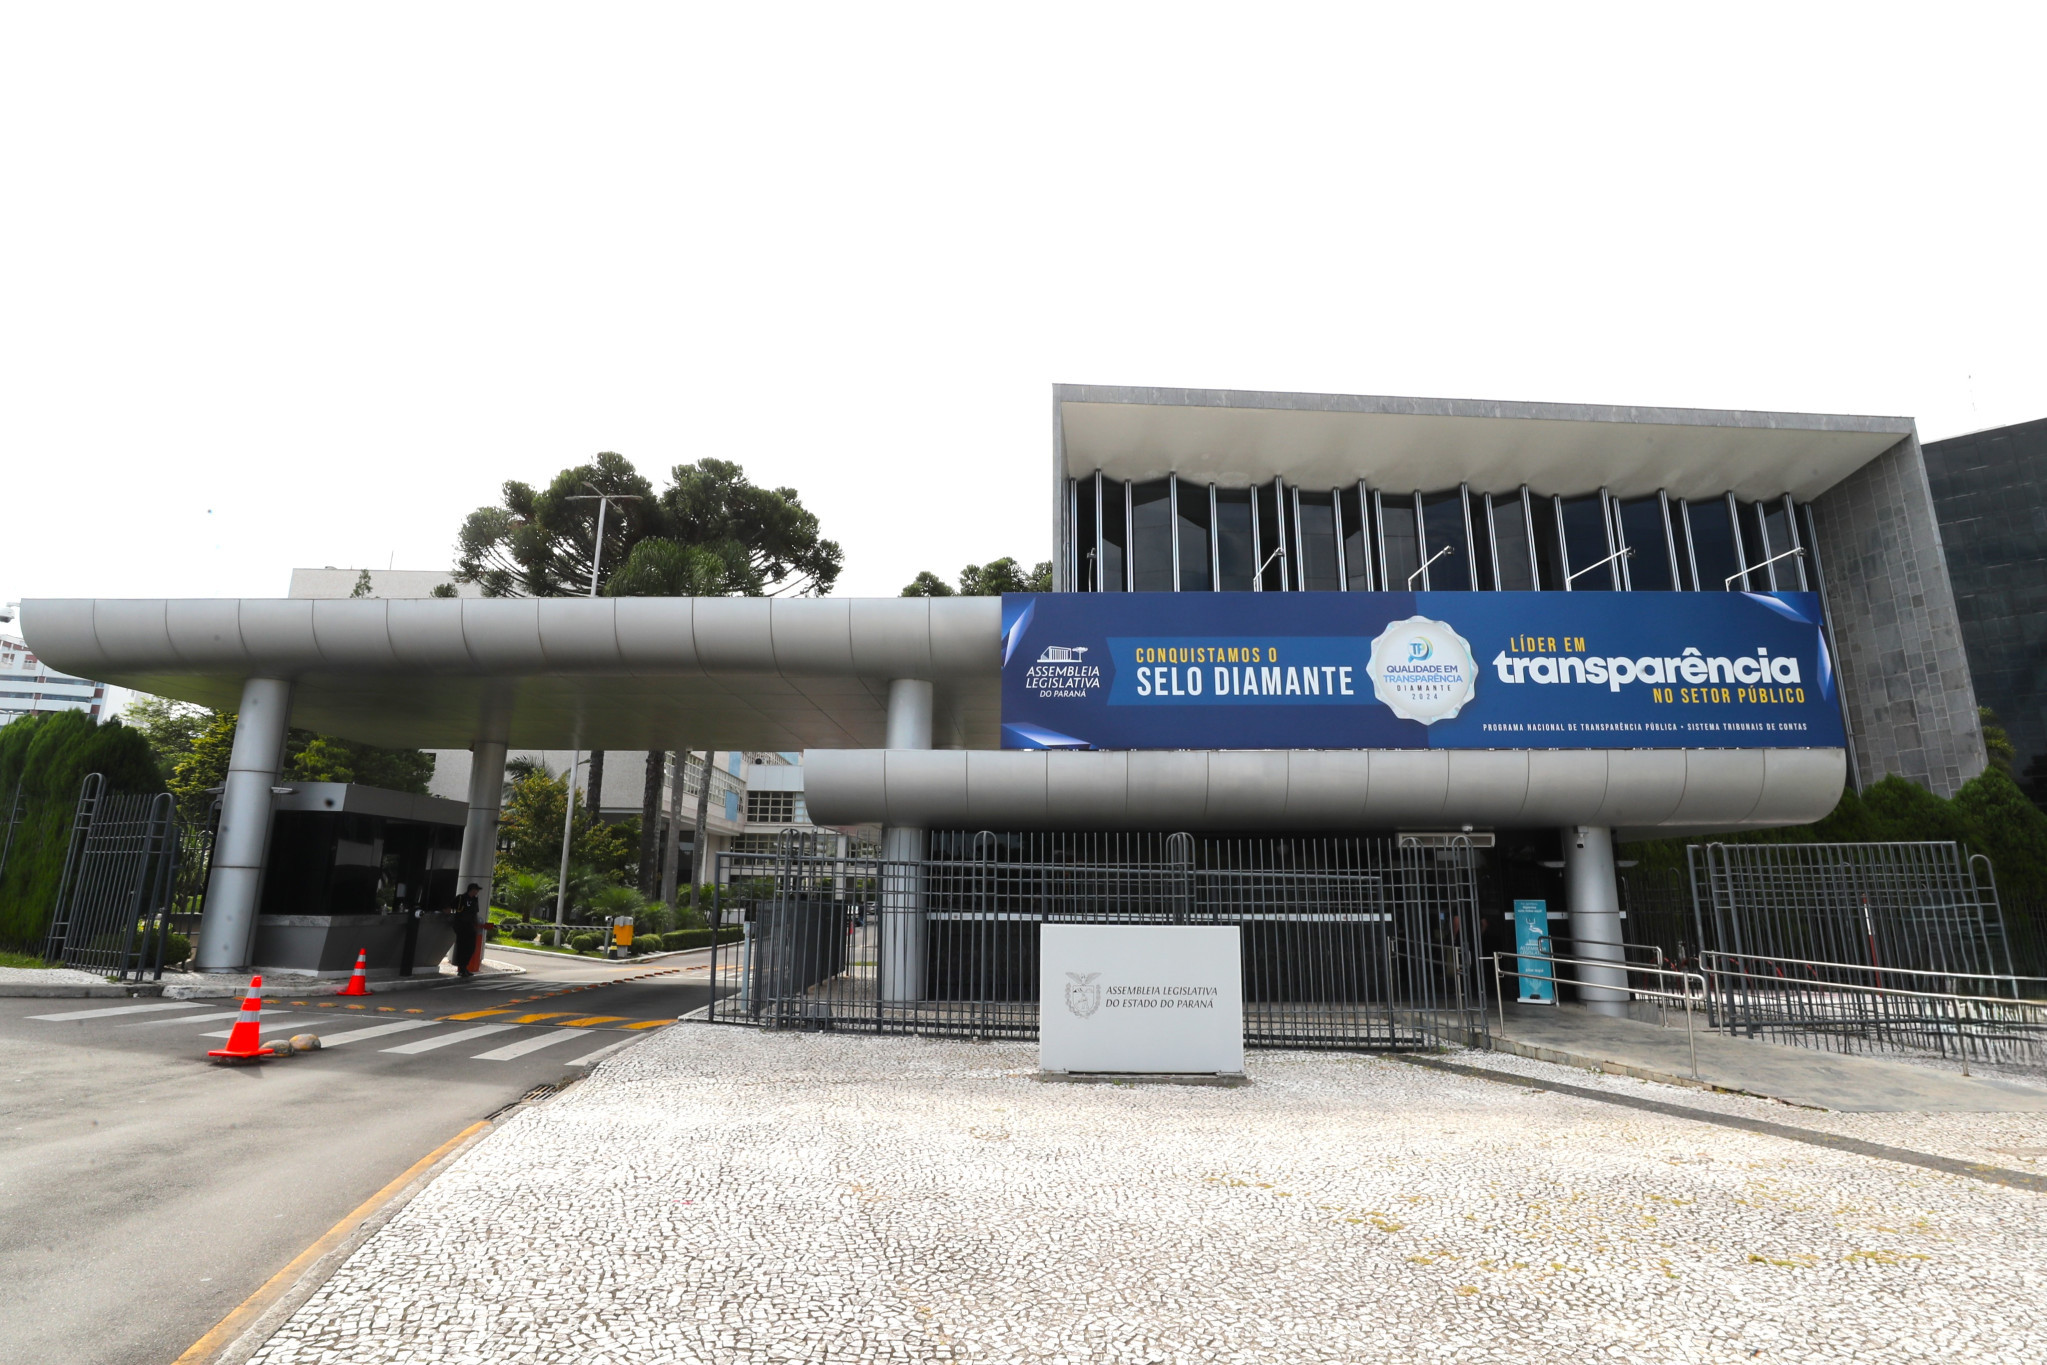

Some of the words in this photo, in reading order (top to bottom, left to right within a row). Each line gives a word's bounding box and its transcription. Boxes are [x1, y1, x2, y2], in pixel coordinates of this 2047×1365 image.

[1510, 634, 1556, 653] LÍDER
[1564, 637, 1586, 653] EM
[1136, 648, 1260, 663] CONQUISTAMOS
[1269, 648, 1278, 663] O
[1026, 666, 1100, 677] ASSEMBLEIA
[1386, 665, 1442, 673] QUALIDADE
[1444, 665, 1458, 673] EM
[1492, 647, 1800, 693] transparência
[1025, 677, 1100, 689] LEGISLATIVA
[1136, 666, 1204, 696] SELO
[1215, 666, 1355, 696] DIAMANTE
[1383, 674, 1463, 682] TRANSPARÊNCIA
[1039, 690, 1052, 698] DO
[1054, 689, 1087, 698] PARANÁ
[1654, 688, 1674, 704] NO
[1682, 688, 1731, 704] SETOR
[1738, 684, 1806, 704] PÚBLICO
[1580, 722, 1643, 731] TRANSPARÊNCIA
[1645, 722, 1678, 731] PÚBLICA
[1106, 986, 1160, 995] ASSEMBLEIA
[1163, 987, 1218, 996] LEGISLATIVA
[1105, 999, 1120, 1007] DO
[1122, 999, 1158, 1009] ESTADO
[1160, 999, 1175, 1009] DO
[1177, 997, 1214, 1009] PARANÁ
